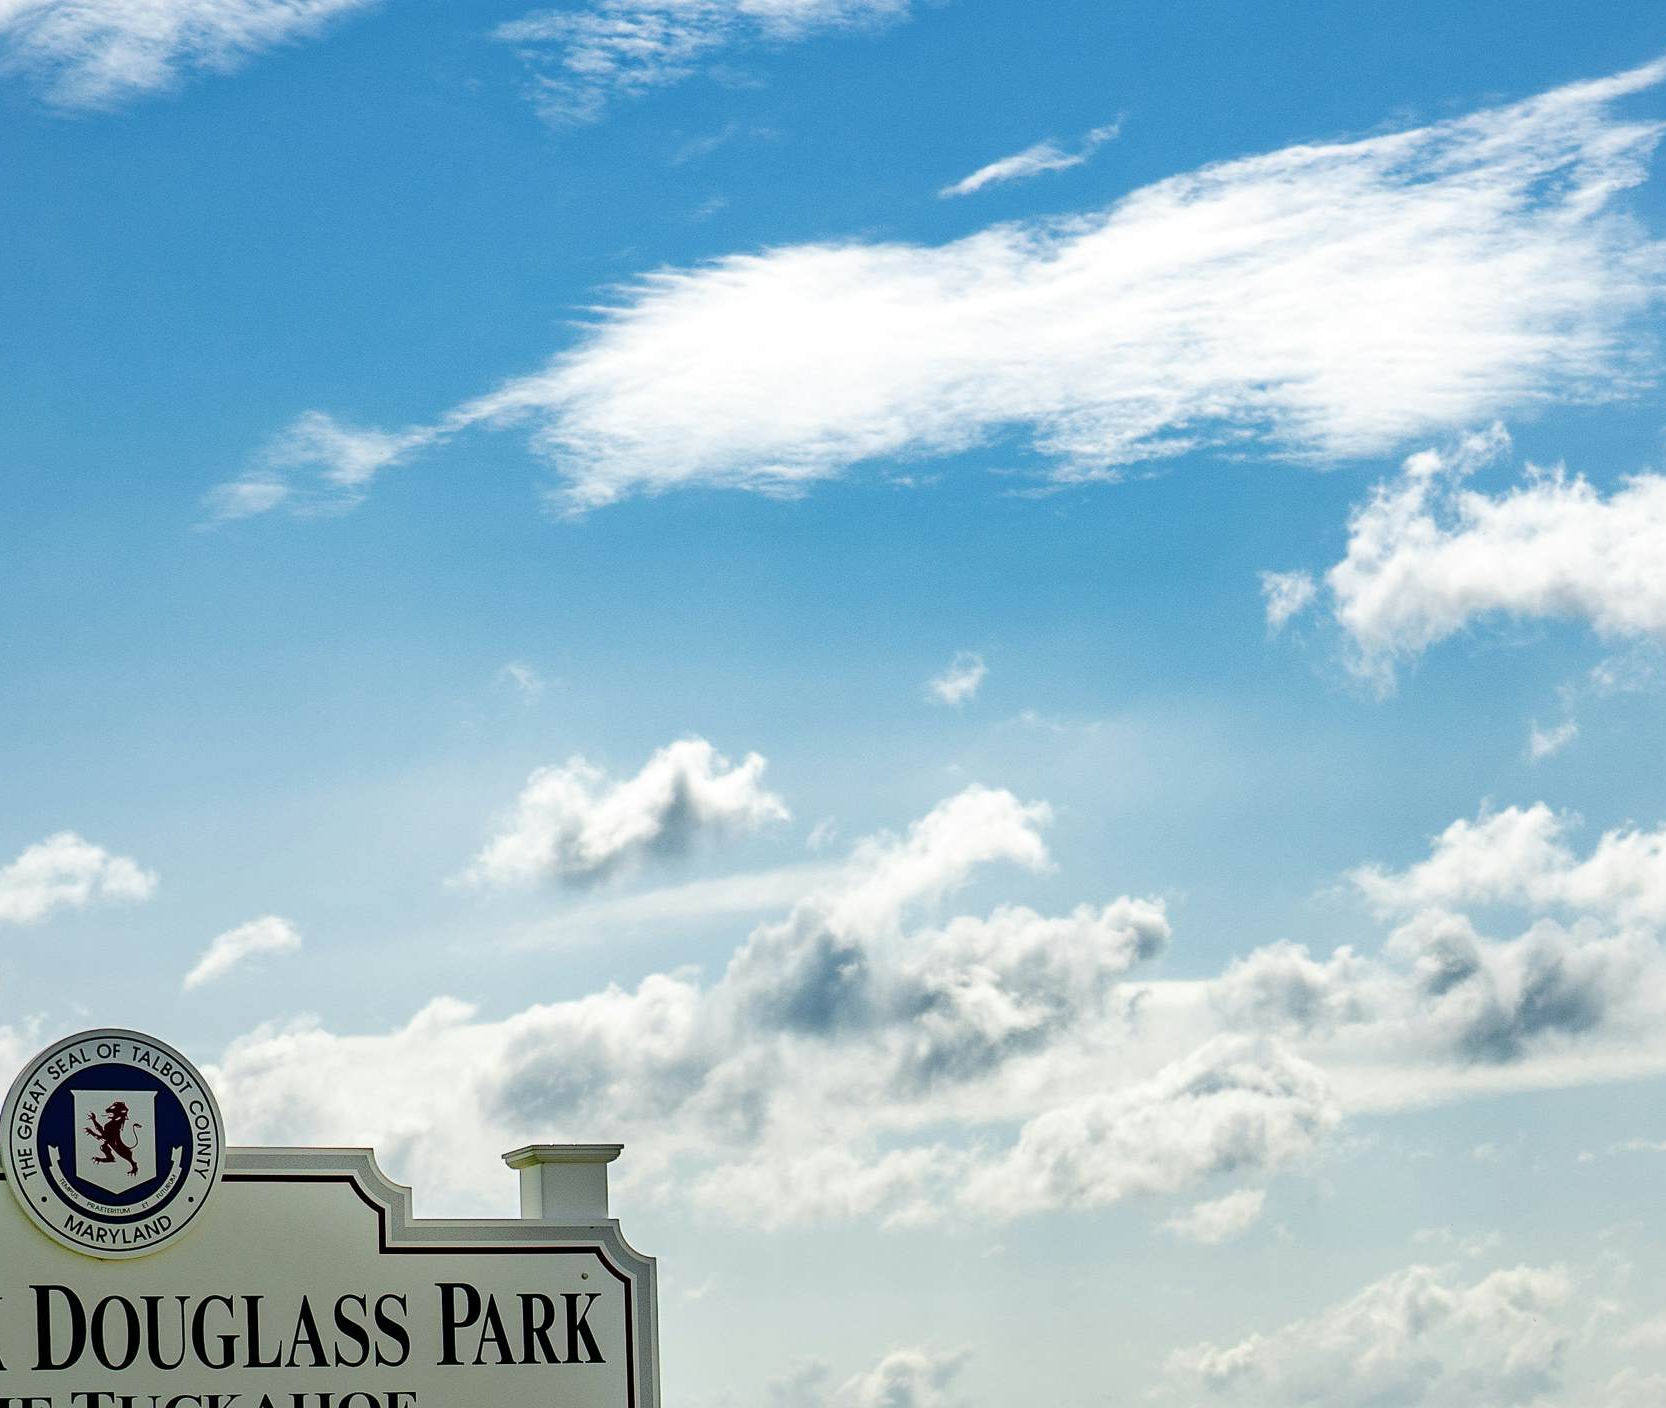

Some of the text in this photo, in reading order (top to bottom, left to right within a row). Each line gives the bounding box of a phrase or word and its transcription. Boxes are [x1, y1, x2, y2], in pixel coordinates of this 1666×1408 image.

[16, 1042, 213, 1181] THE GREAT SEAL OF TALBOT COUNTY
[62, 1213, 173, 1245] MARYLAND
[27, 1283, 412, 1372] DOUGLASS
[434, 1281, 608, 1367] PARK
